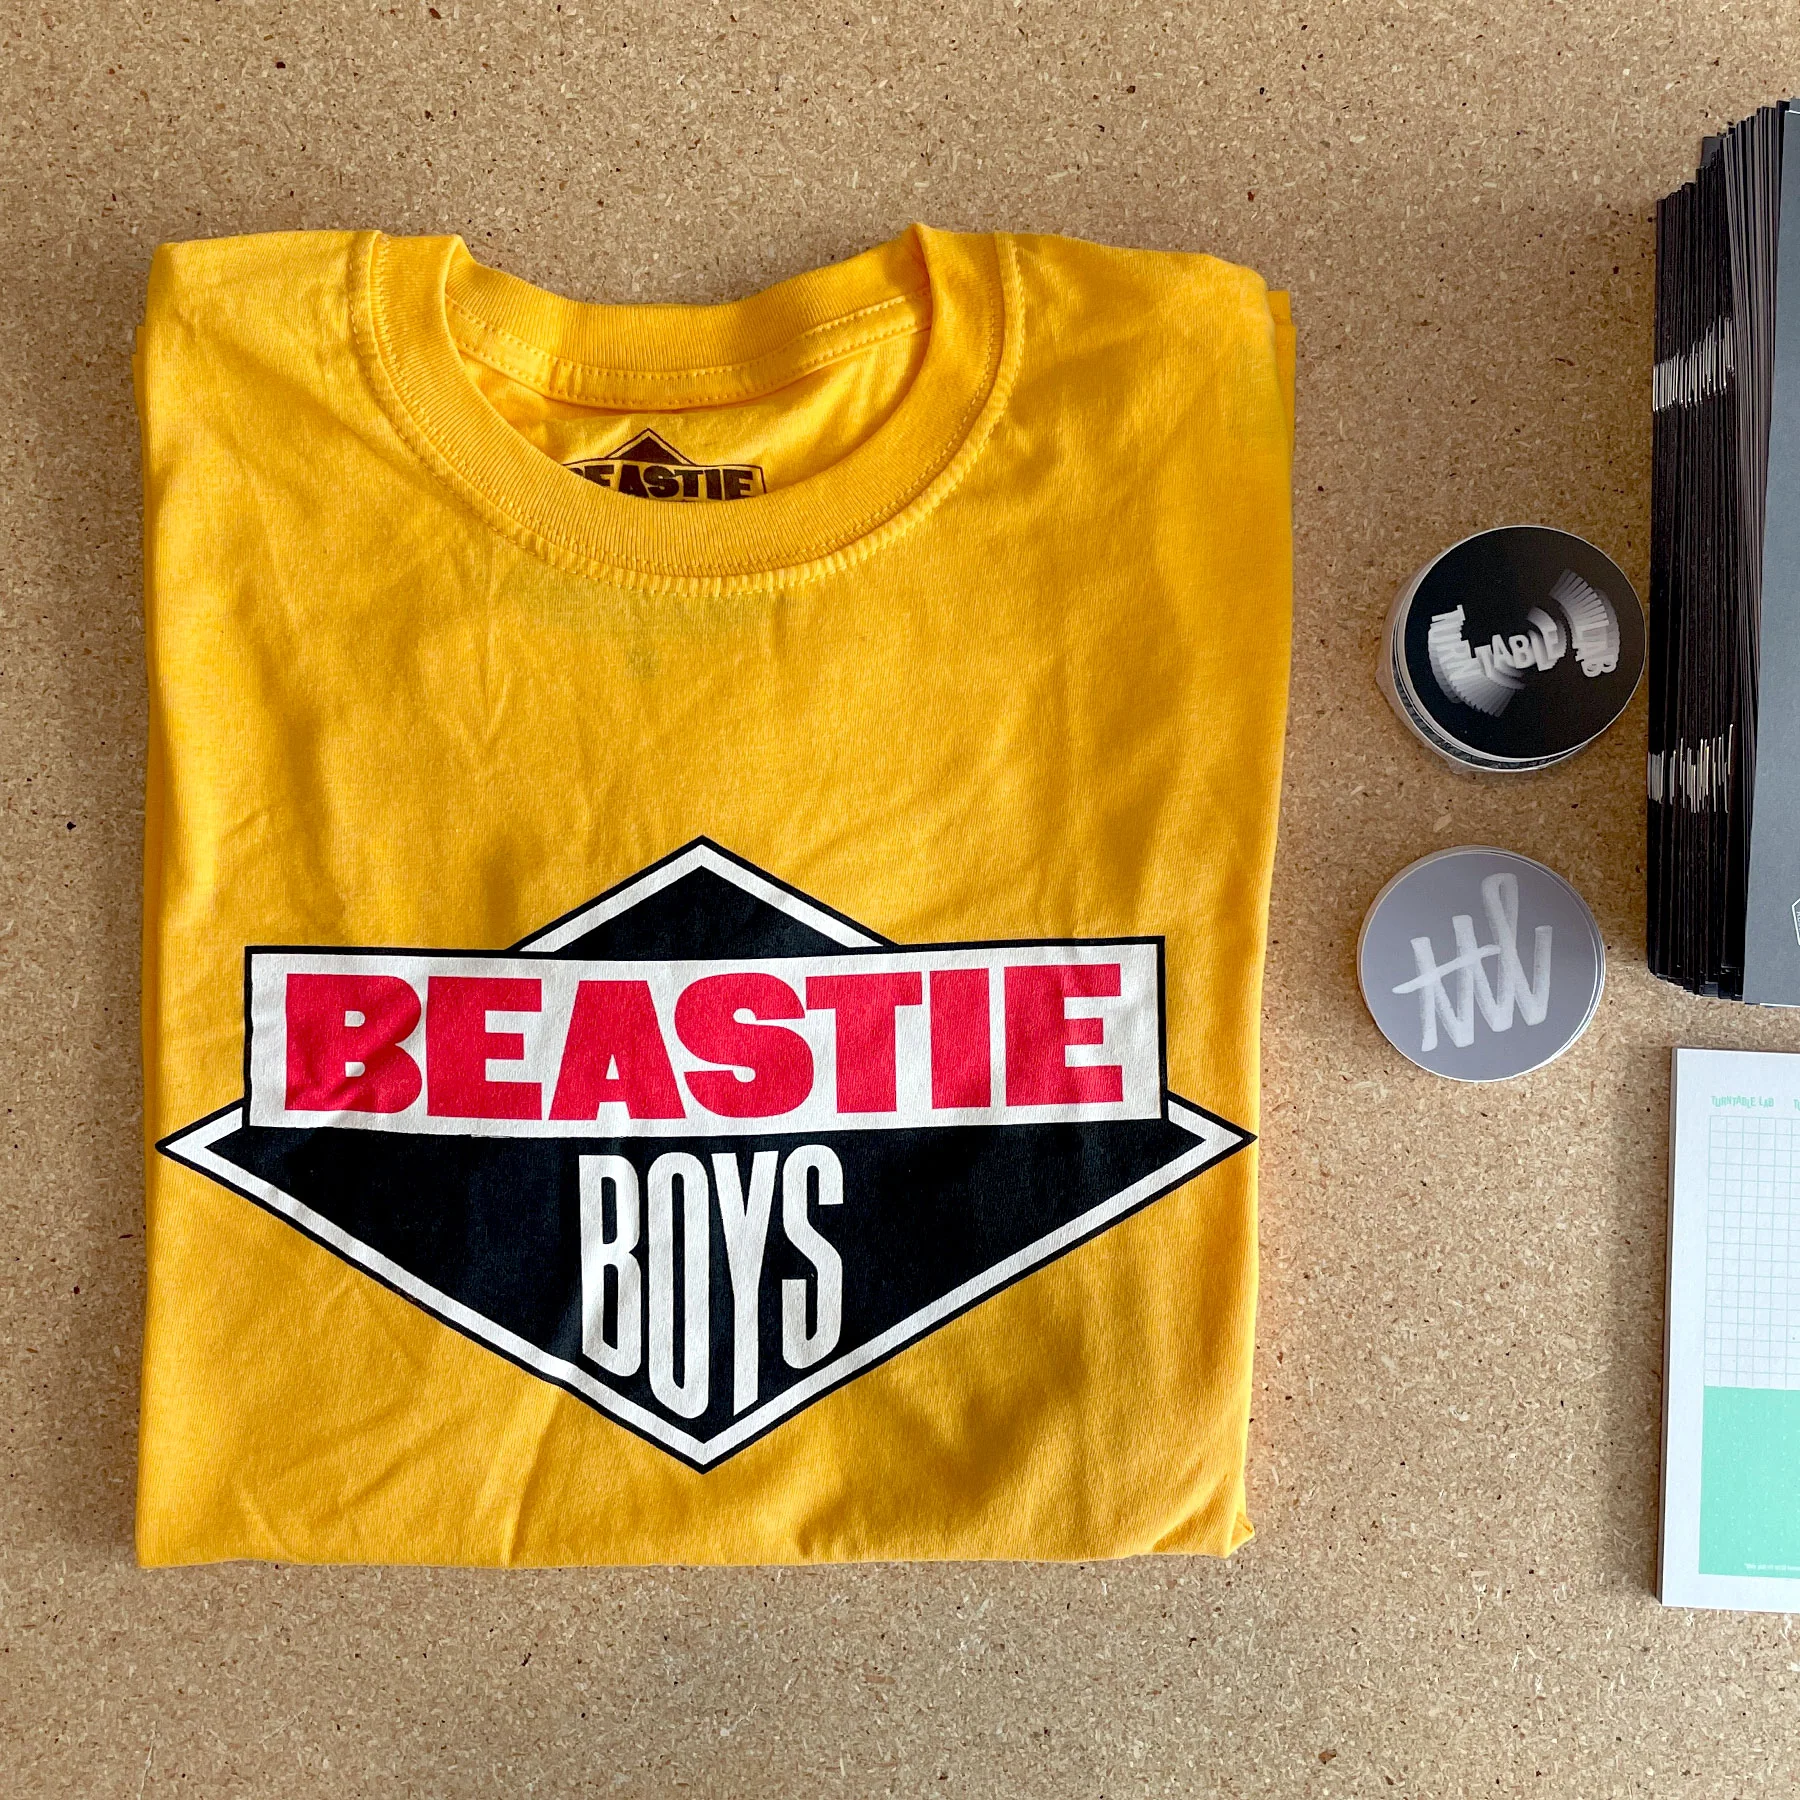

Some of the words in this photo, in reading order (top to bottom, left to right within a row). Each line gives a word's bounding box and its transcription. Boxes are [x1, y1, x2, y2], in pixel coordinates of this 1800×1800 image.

[567, 464, 754, 501] EASTIE
[285, 962, 1123, 1120] BEASTIE
[579, 1144, 844, 1419] BOYS
